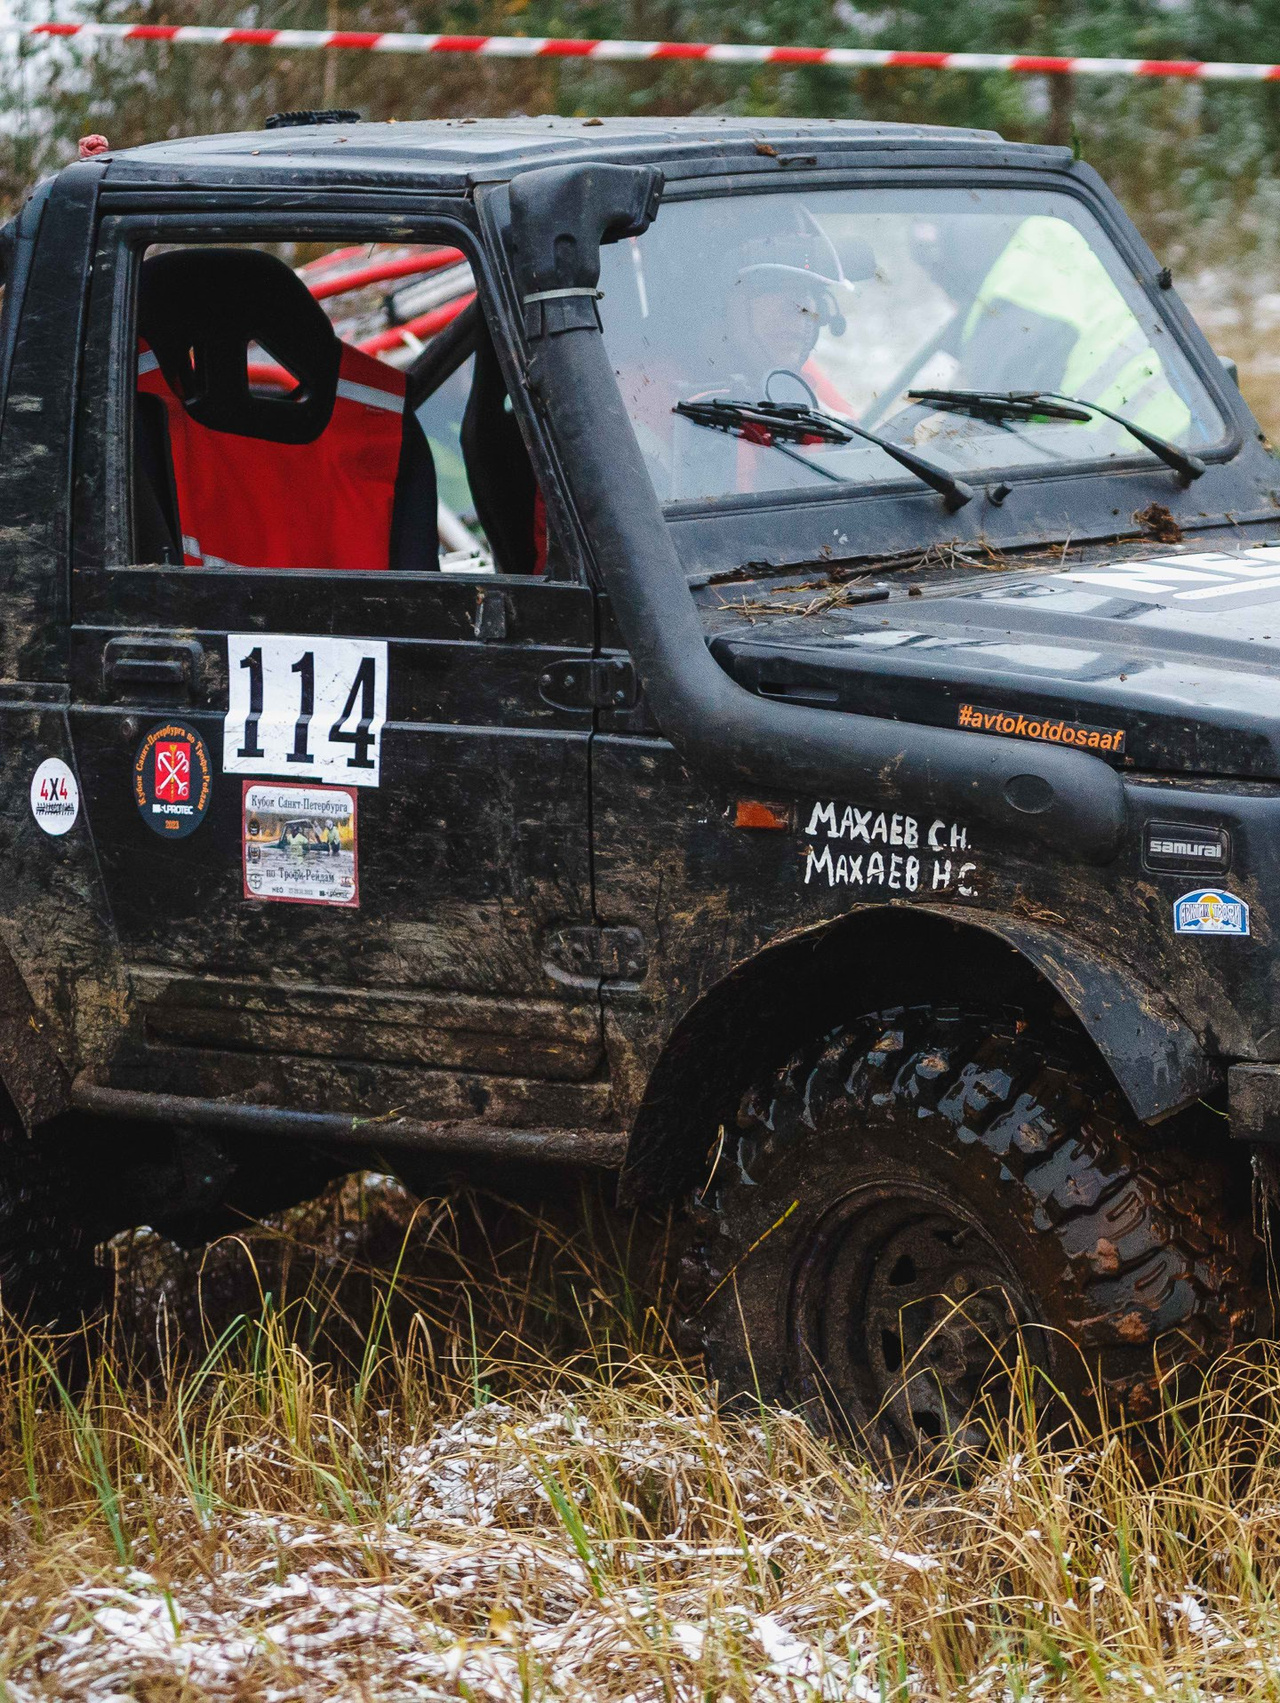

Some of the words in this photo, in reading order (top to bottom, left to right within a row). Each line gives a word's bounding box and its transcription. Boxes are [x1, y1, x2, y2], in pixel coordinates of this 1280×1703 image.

[237, 647, 375, 769] 114
[959, 704, 1125, 751] #avtokotdosaaf
[251, 794, 275, 809] Кубок
[278, 796, 348, 815] Санкт-Петербурга
[804, 801, 919, 849] МАХАЕВ
[804, 844, 920, 892] МАХАЕВ
[1150, 840, 1222, 857] samurai
